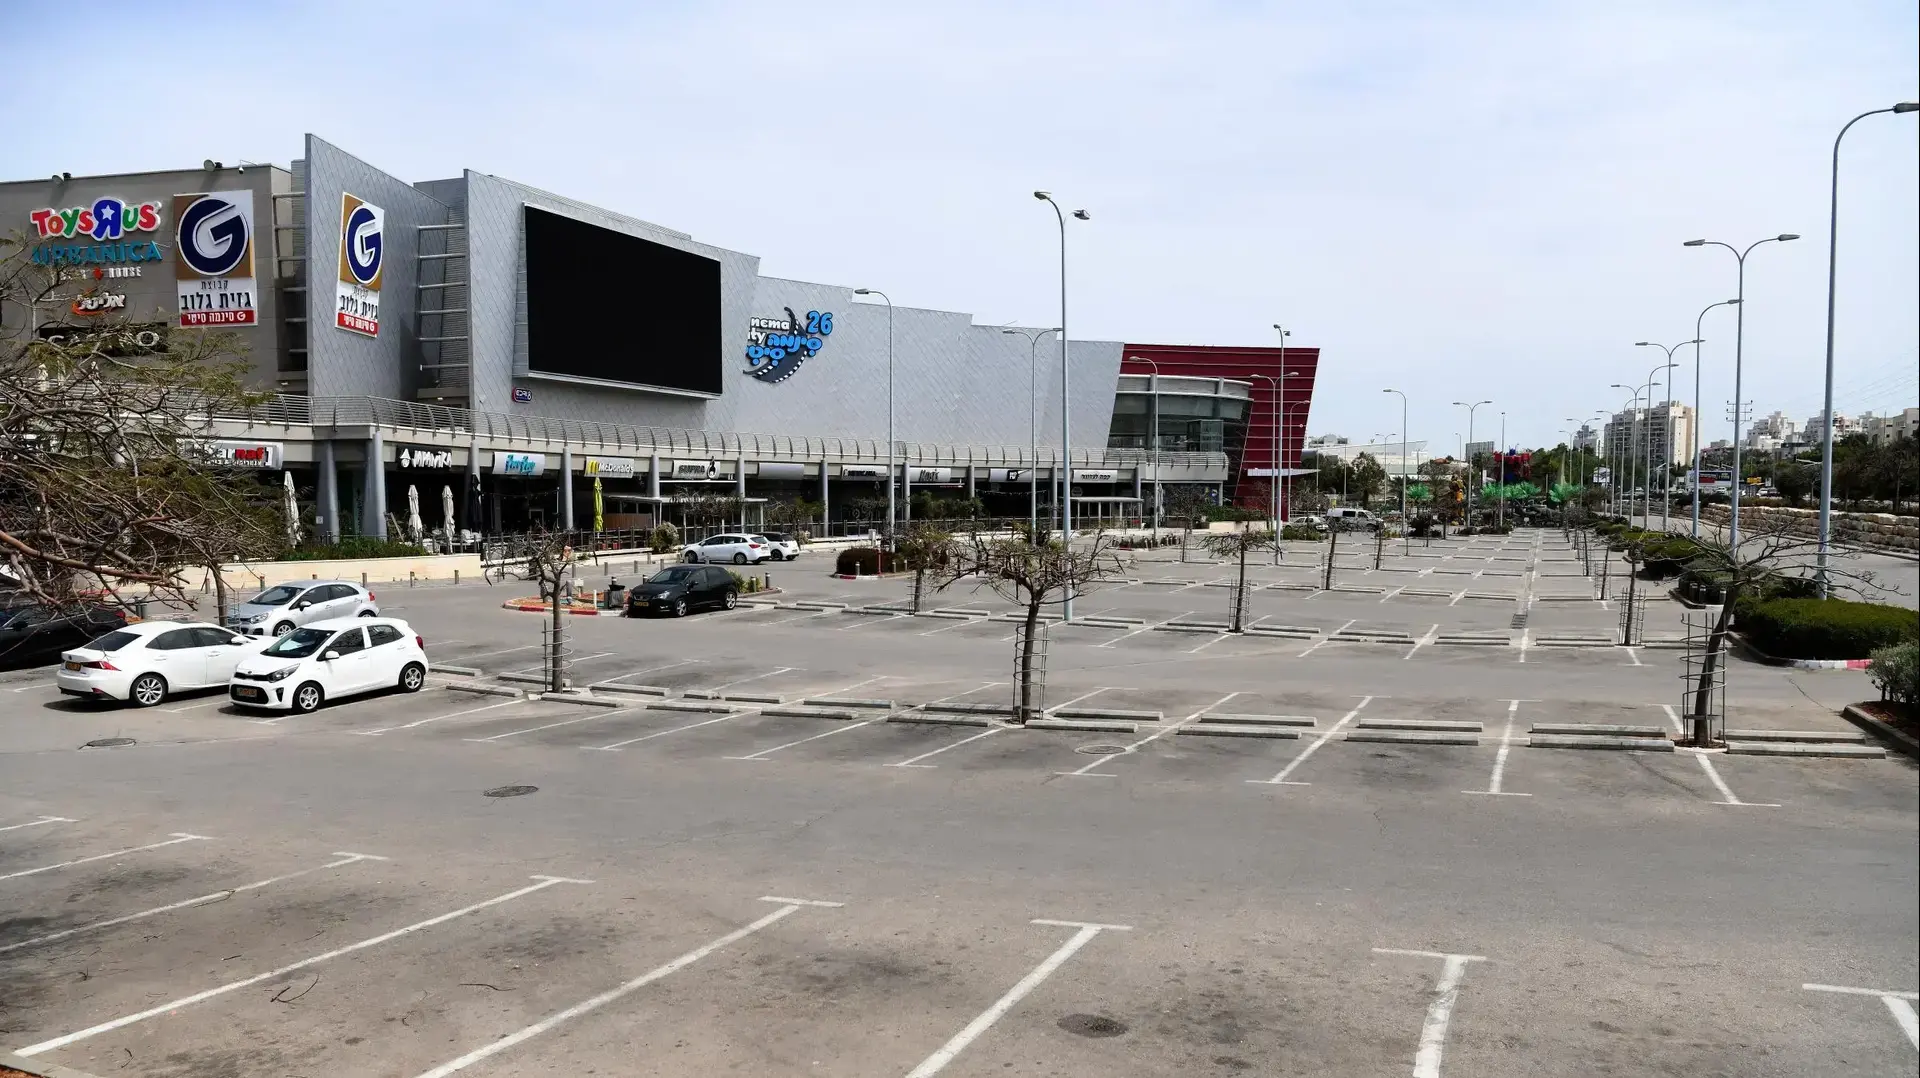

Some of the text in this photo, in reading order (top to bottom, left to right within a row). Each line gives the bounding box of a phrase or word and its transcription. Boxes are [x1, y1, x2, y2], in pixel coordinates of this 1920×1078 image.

[33, 240, 162, 266] URBANICA
[108, 266, 142, 278] HOUSE
[201, 280, 228, 290] קבוצת
[180, 291, 253, 310] גזית גלוב
[806, 310, 833, 336] 26
